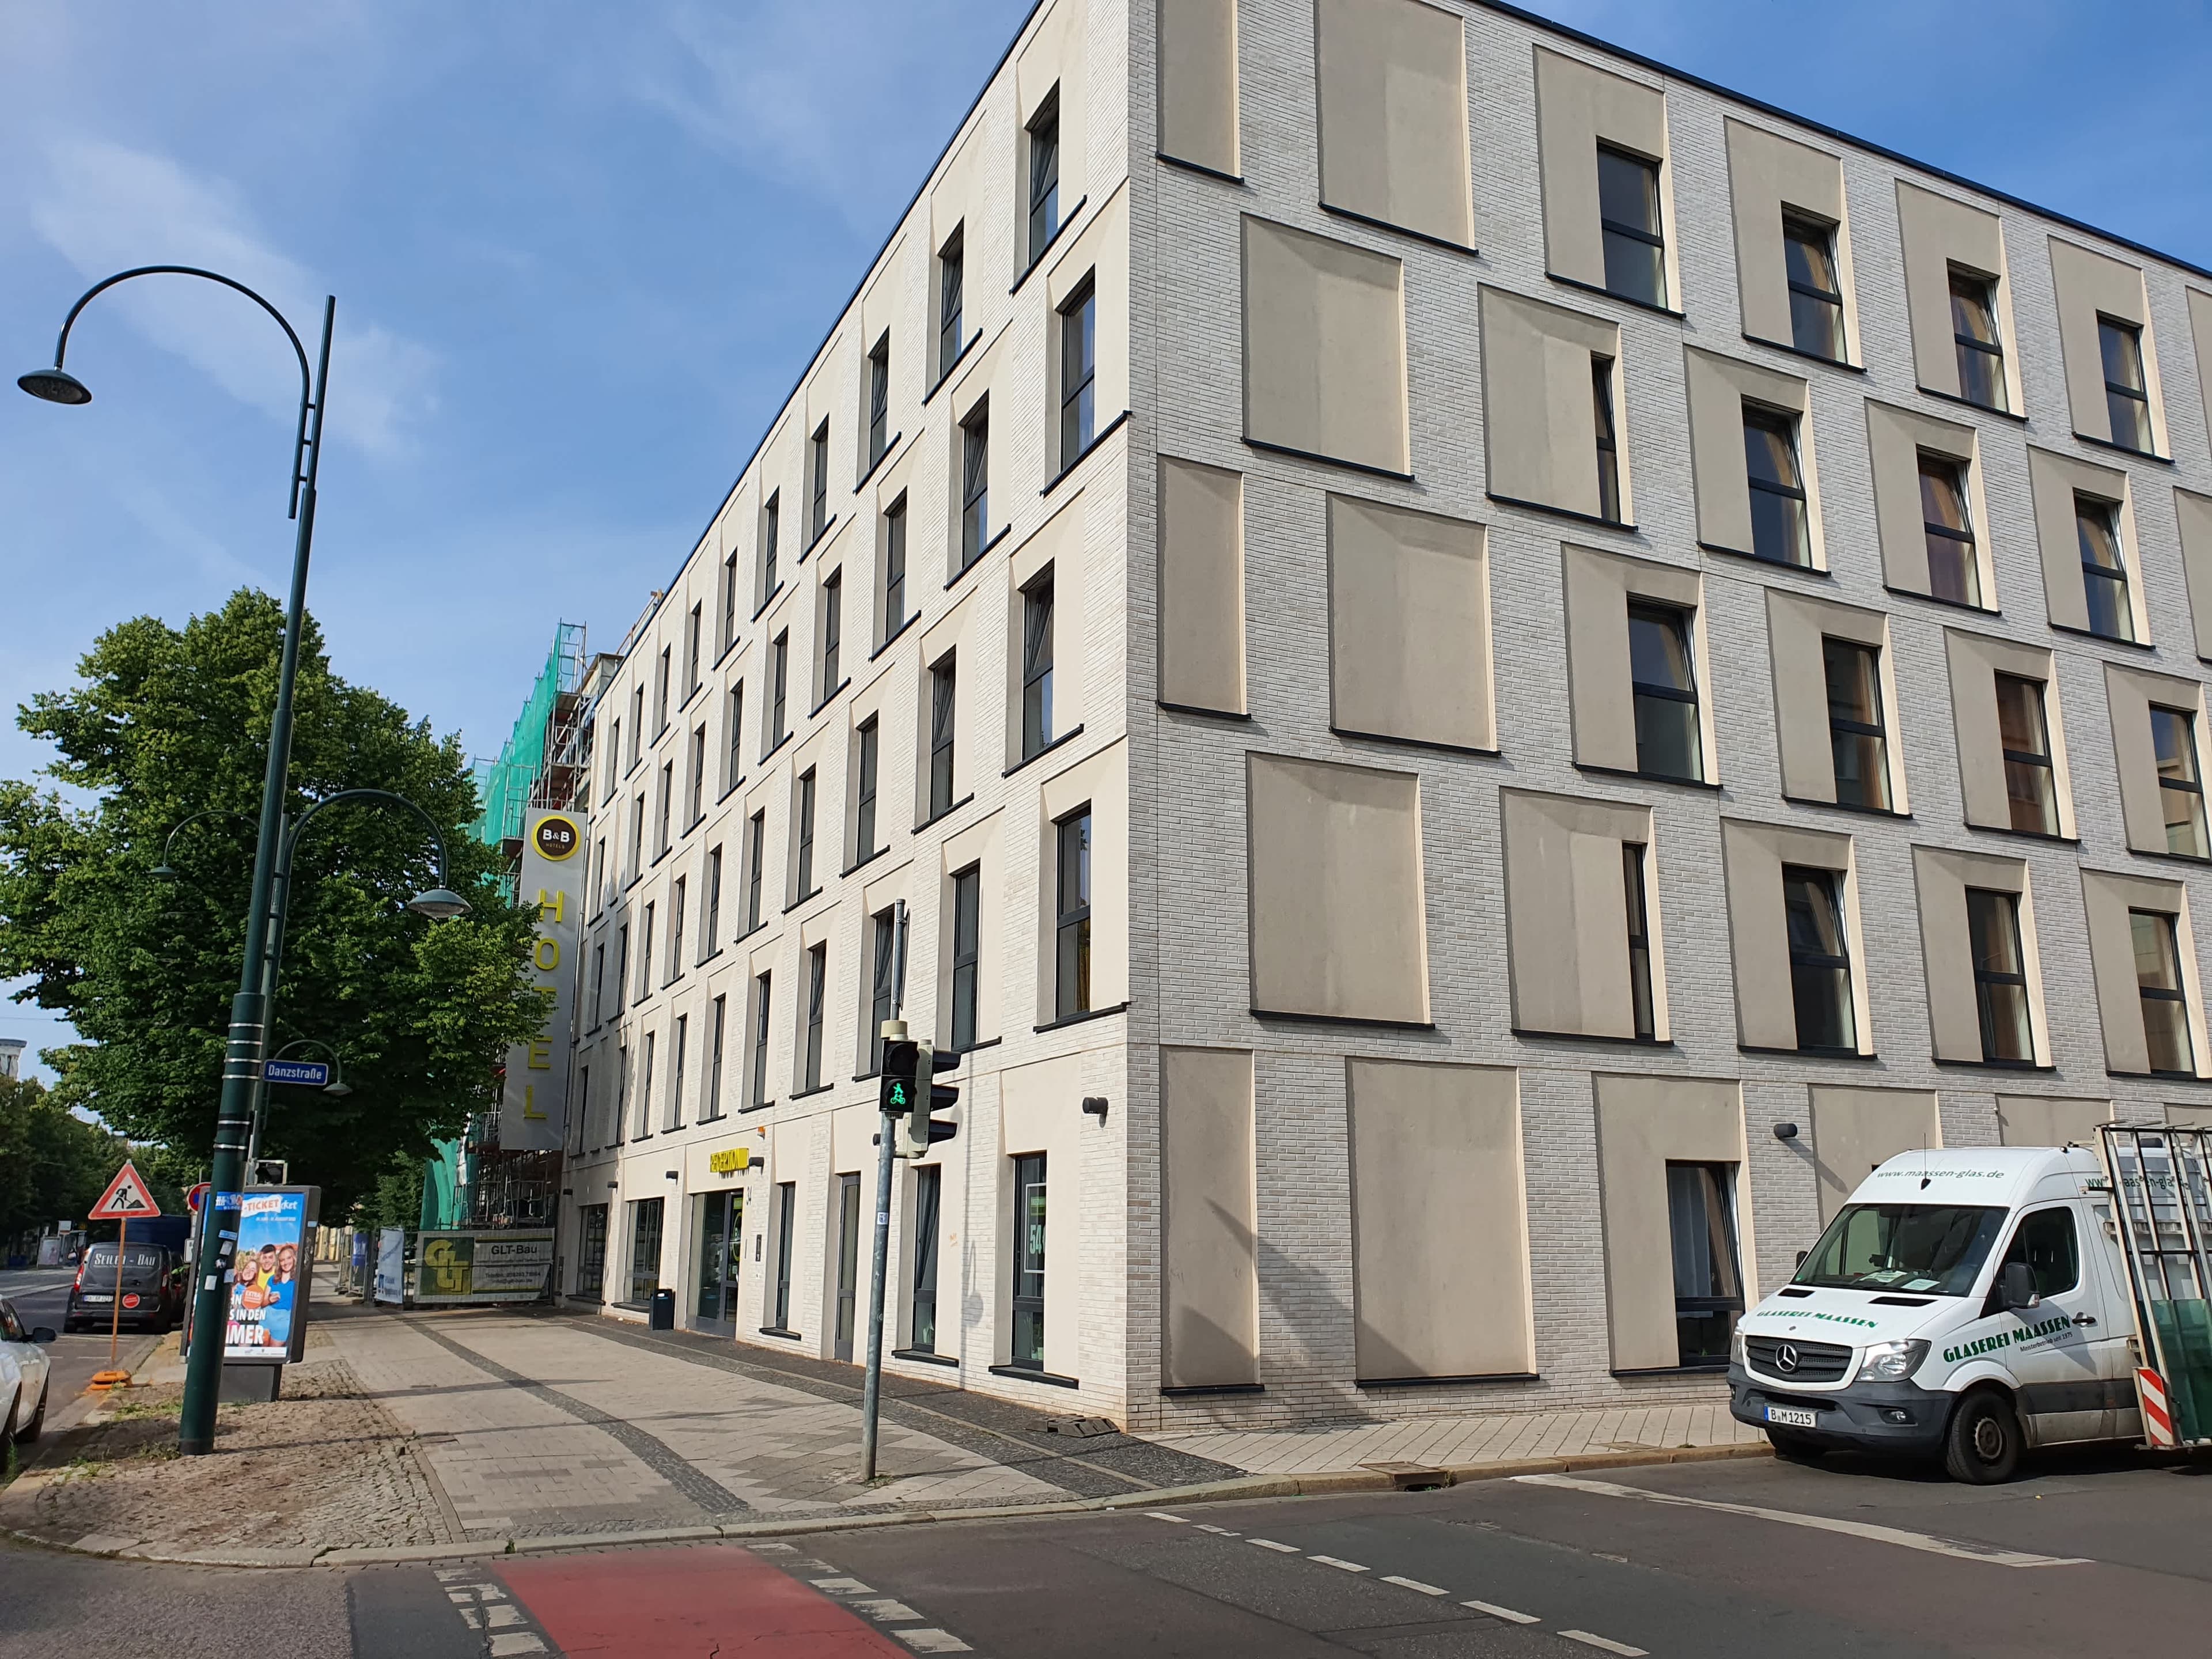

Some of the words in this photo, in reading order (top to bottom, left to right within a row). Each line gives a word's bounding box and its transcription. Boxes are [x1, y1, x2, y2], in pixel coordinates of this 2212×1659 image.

[543, 829, 570, 842] B&B
[268, 1065, 322, 1080] Danzstraße
[1877, 1169, 2004, 1179] www.maassen-glas.de
[491, 1245, 537, 1255] GLT-Bau
[248, 1309, 266, 1320] DEN
[1813, 1313, 1878, 1328] MAASSEN
[1943, 1332, 2010, 1363] GLASEREI
[2013, 1315, 2071, 1343] MAASSEN
[2020, 1338, 2053, 1353] Meisterbetrieb
[2062, 1331, 2073, 1339] 1975
[1771, 1409, 1777, 1420] B
